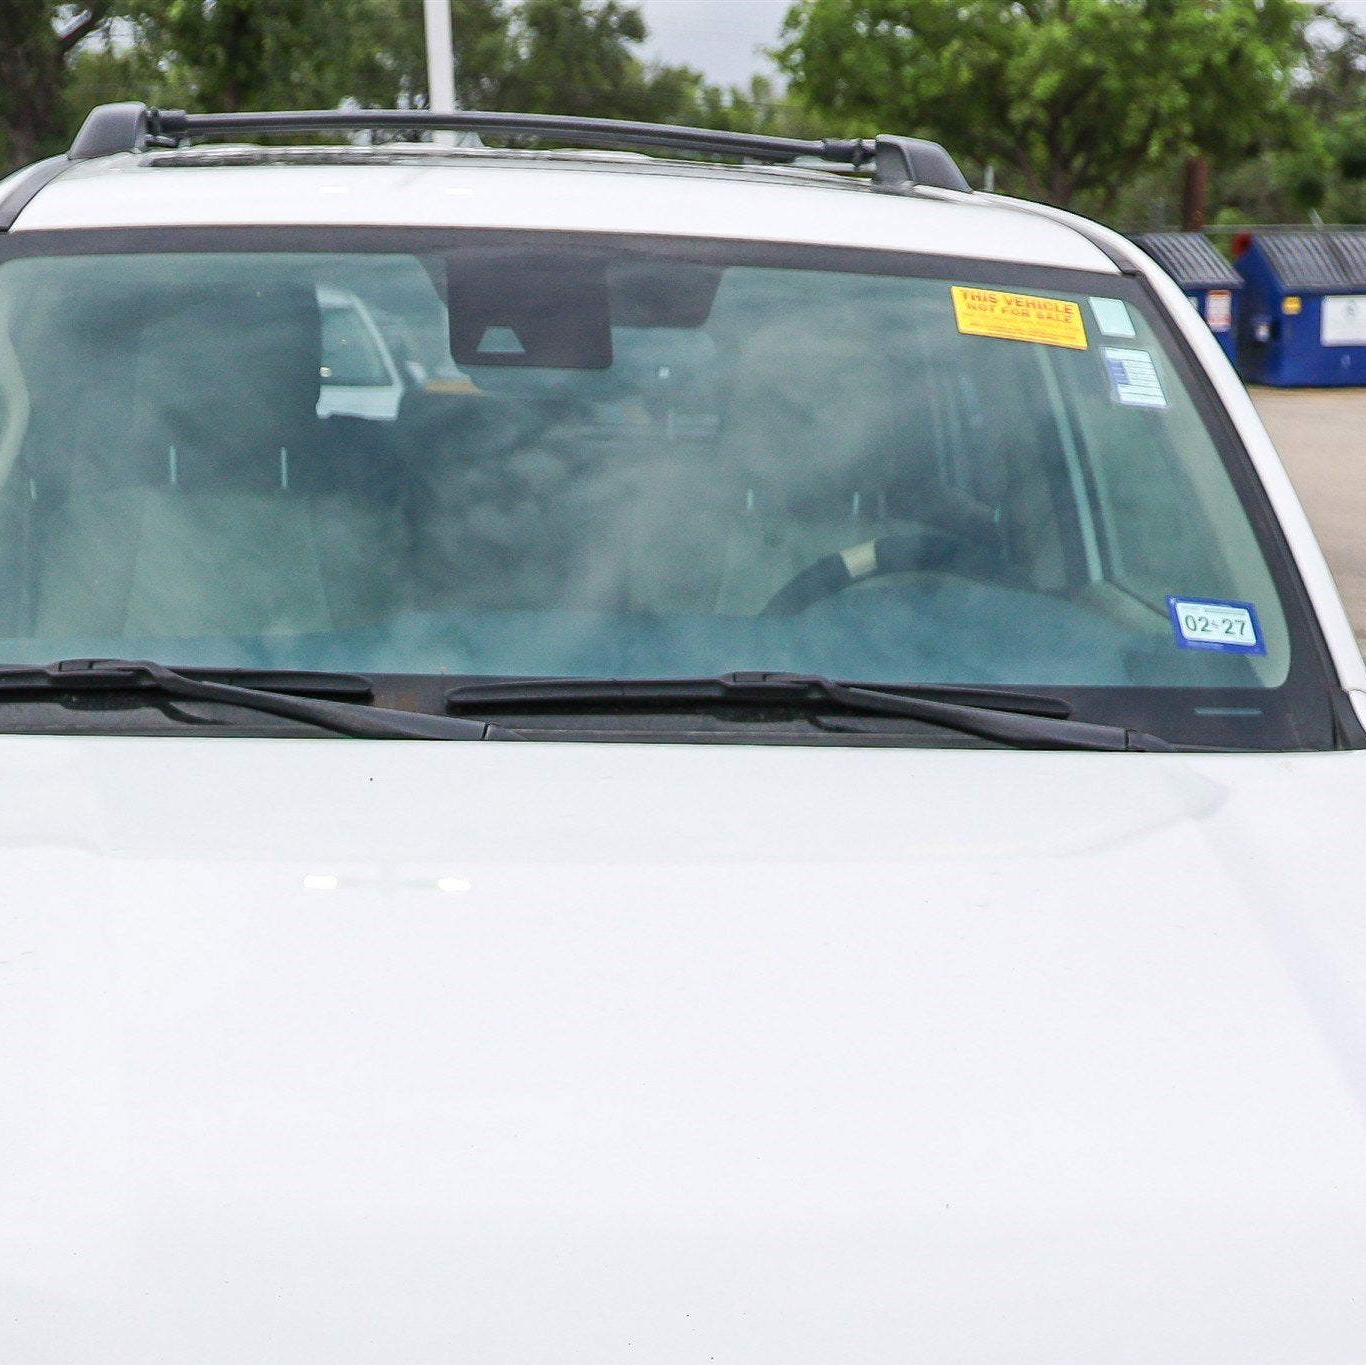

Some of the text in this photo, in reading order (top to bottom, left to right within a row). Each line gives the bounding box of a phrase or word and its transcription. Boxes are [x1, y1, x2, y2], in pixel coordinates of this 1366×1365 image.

[961, 290, 1074, 315] THIS VEHICLE
[967, 301, 1073, 323] NOT FOR SALE
